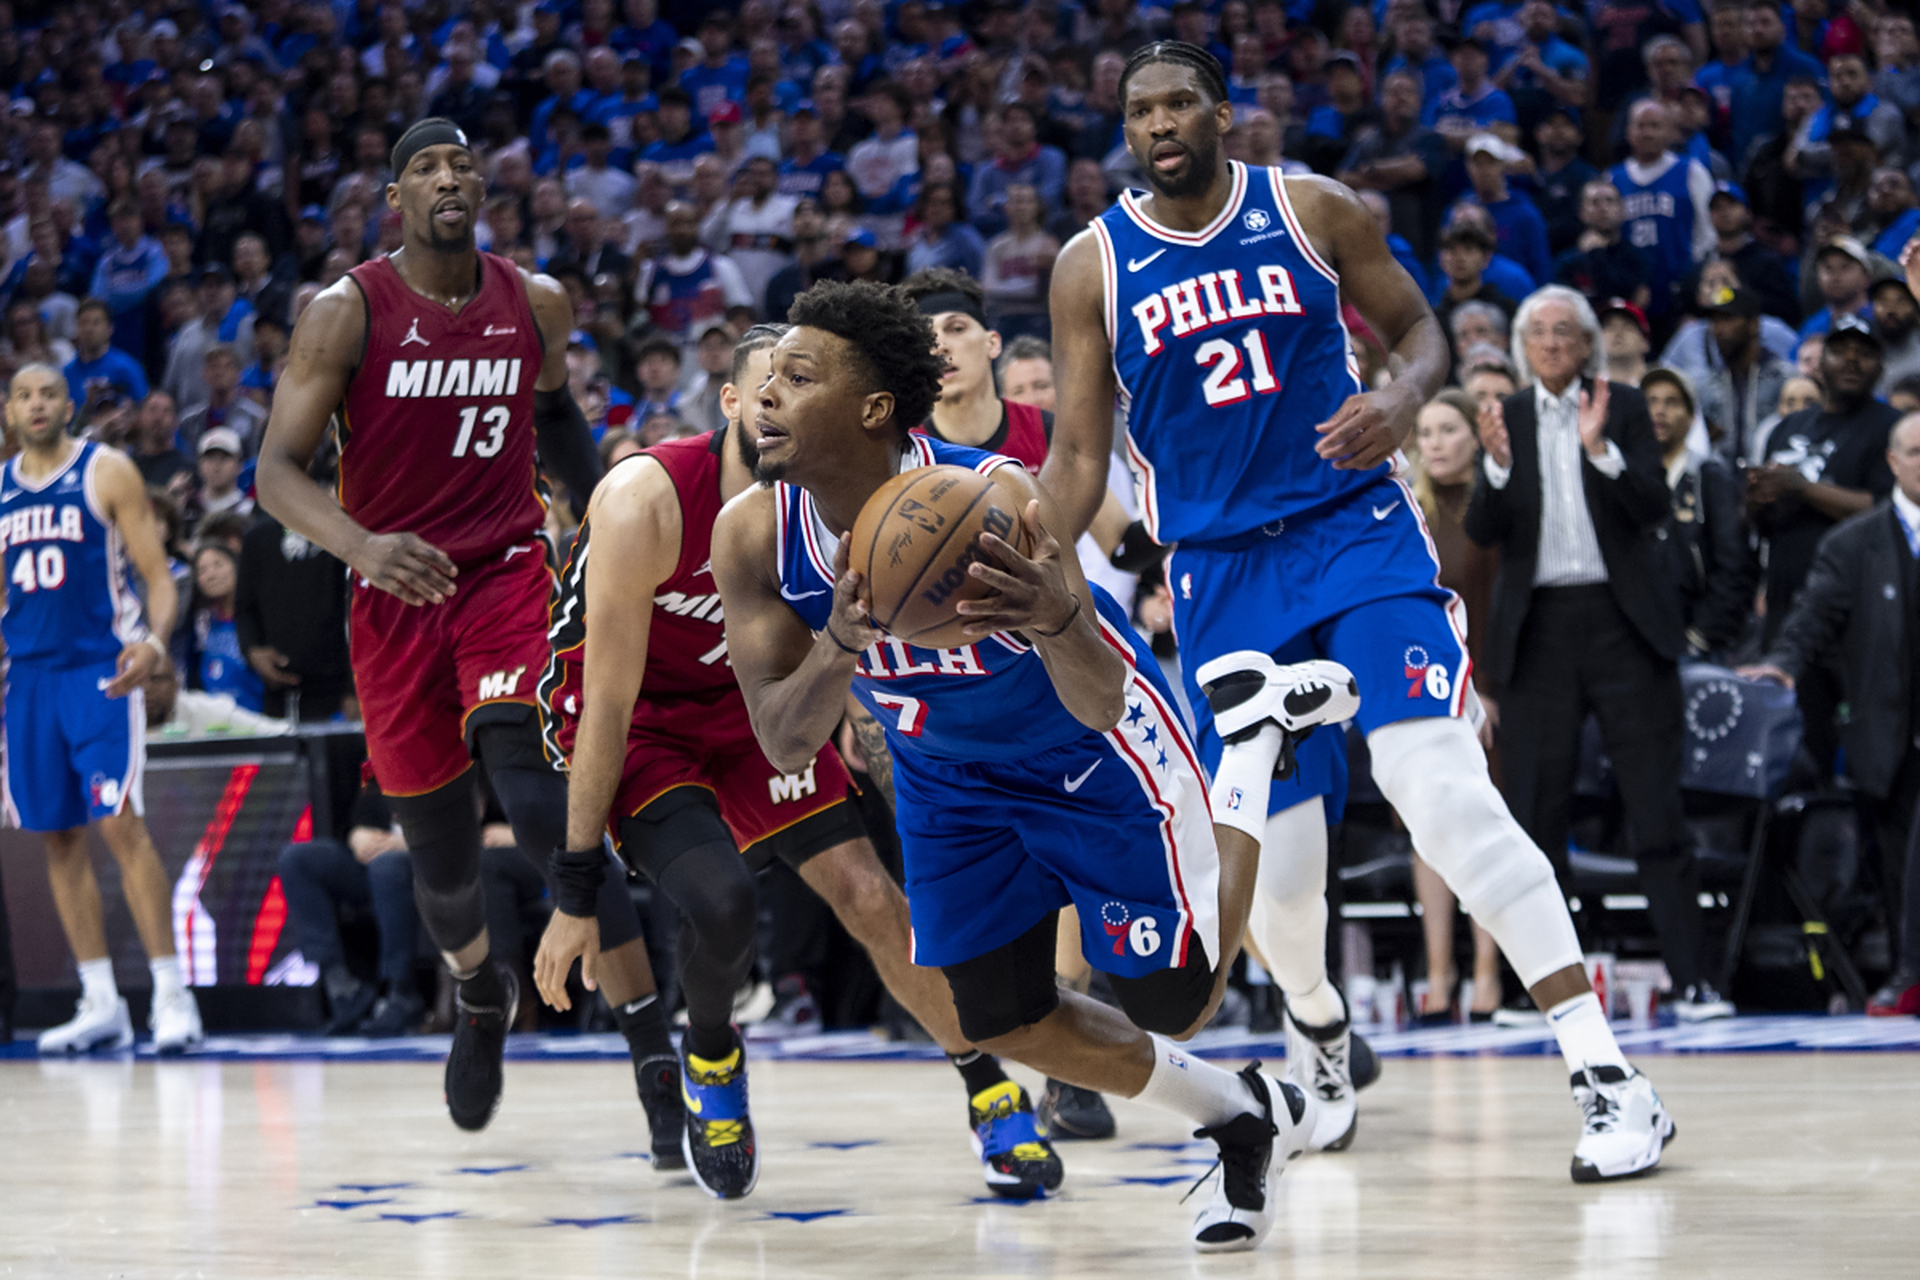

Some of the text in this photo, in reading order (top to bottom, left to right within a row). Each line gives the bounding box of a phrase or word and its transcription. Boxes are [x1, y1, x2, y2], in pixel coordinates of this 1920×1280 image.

[1239, 229, 1285, 246] crypto.com
[1131, 264, 1306, 358] PHILA
[385, 358, 522, 398] MIAMI
[1194, 328, 1282, 409] 21
[451, 405, 511, 458] 13
[12, 545, 66, 594] 40
[921, 504, 1015, 607] Wlson
[1404, 661, 1450, 700] 76
[870, 690, 929, 737] 7
[1102, 914, 1161, 957] 76
